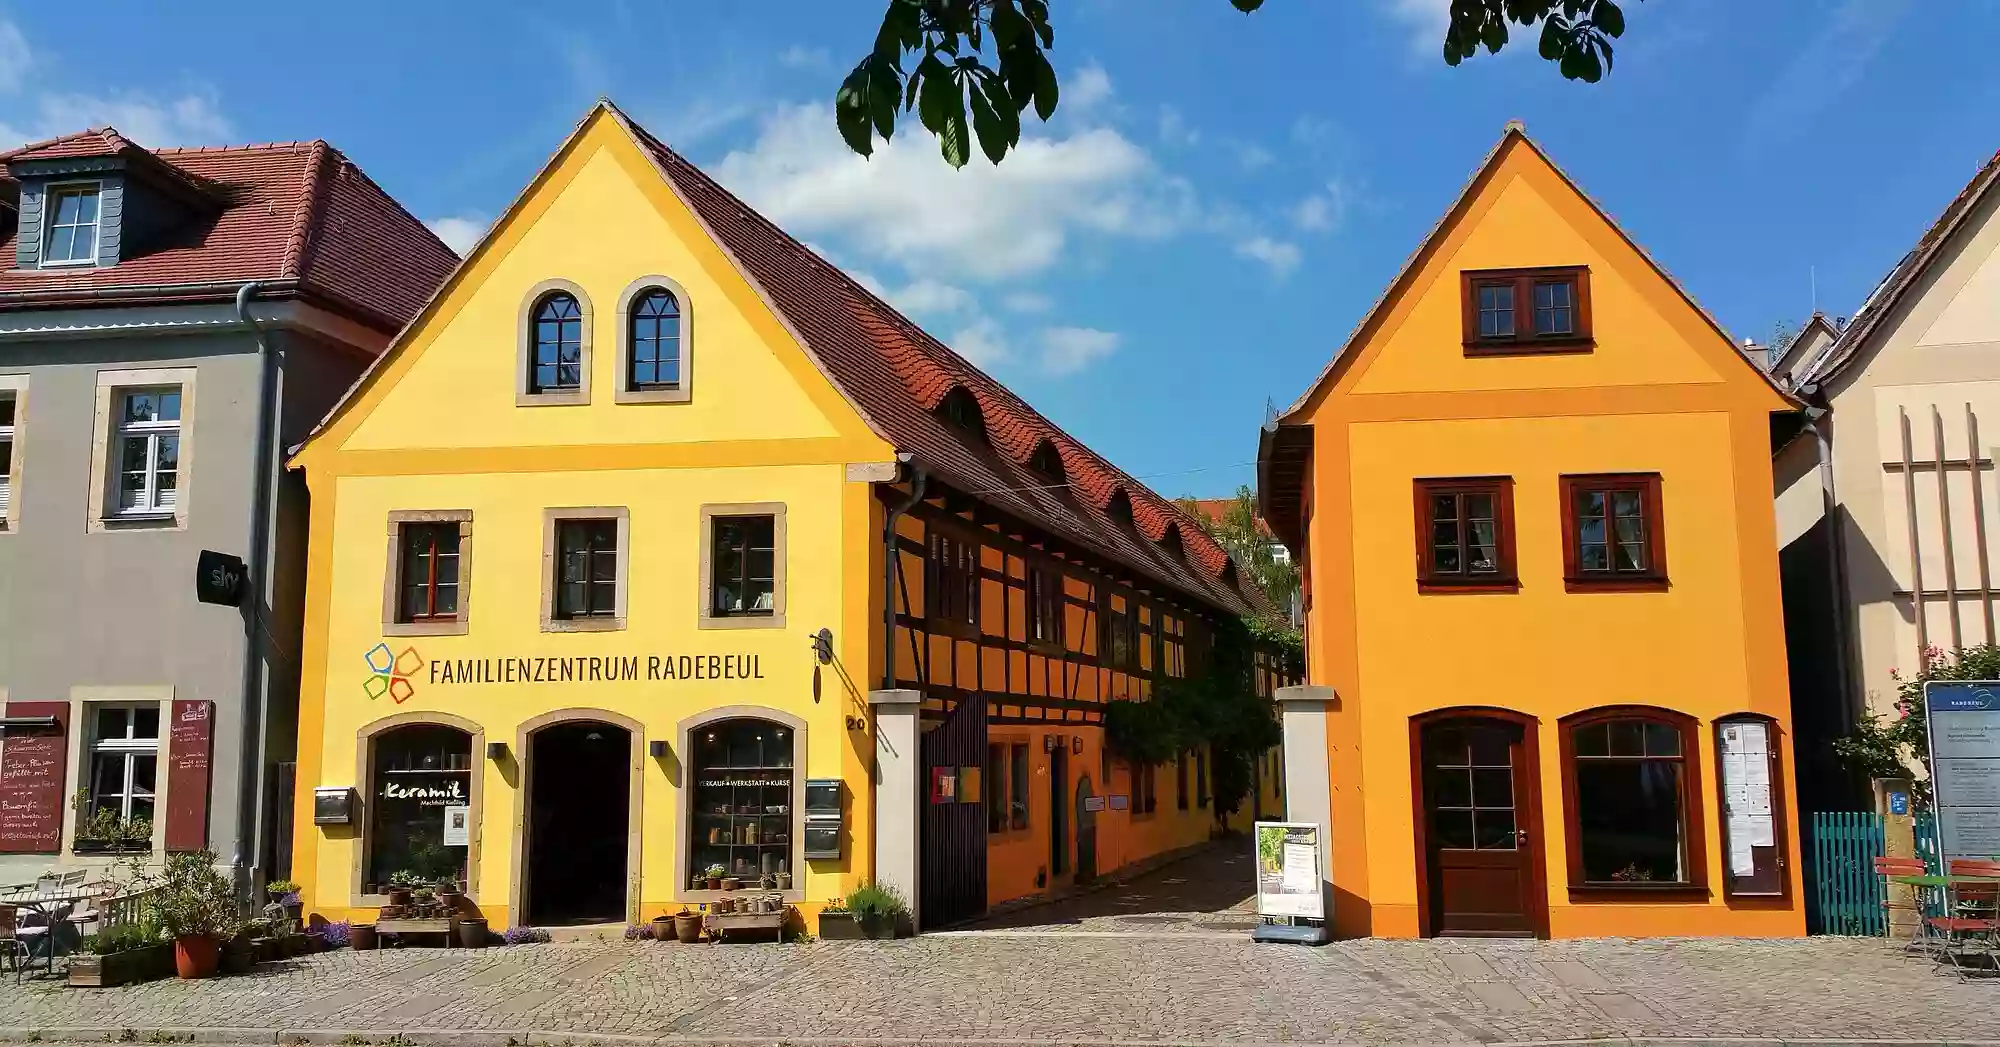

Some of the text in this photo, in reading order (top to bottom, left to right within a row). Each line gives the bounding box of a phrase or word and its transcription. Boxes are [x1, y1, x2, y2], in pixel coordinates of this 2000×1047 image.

[211, 564, 239, 592] sky
[430, 654, 764, 684] FAMILIENZENTRUM RADEBEUL
[846, 718, 865, 730] 20
[380, 781, 466, 800] Keramik
[770, 779, 791, 787] KURSE
